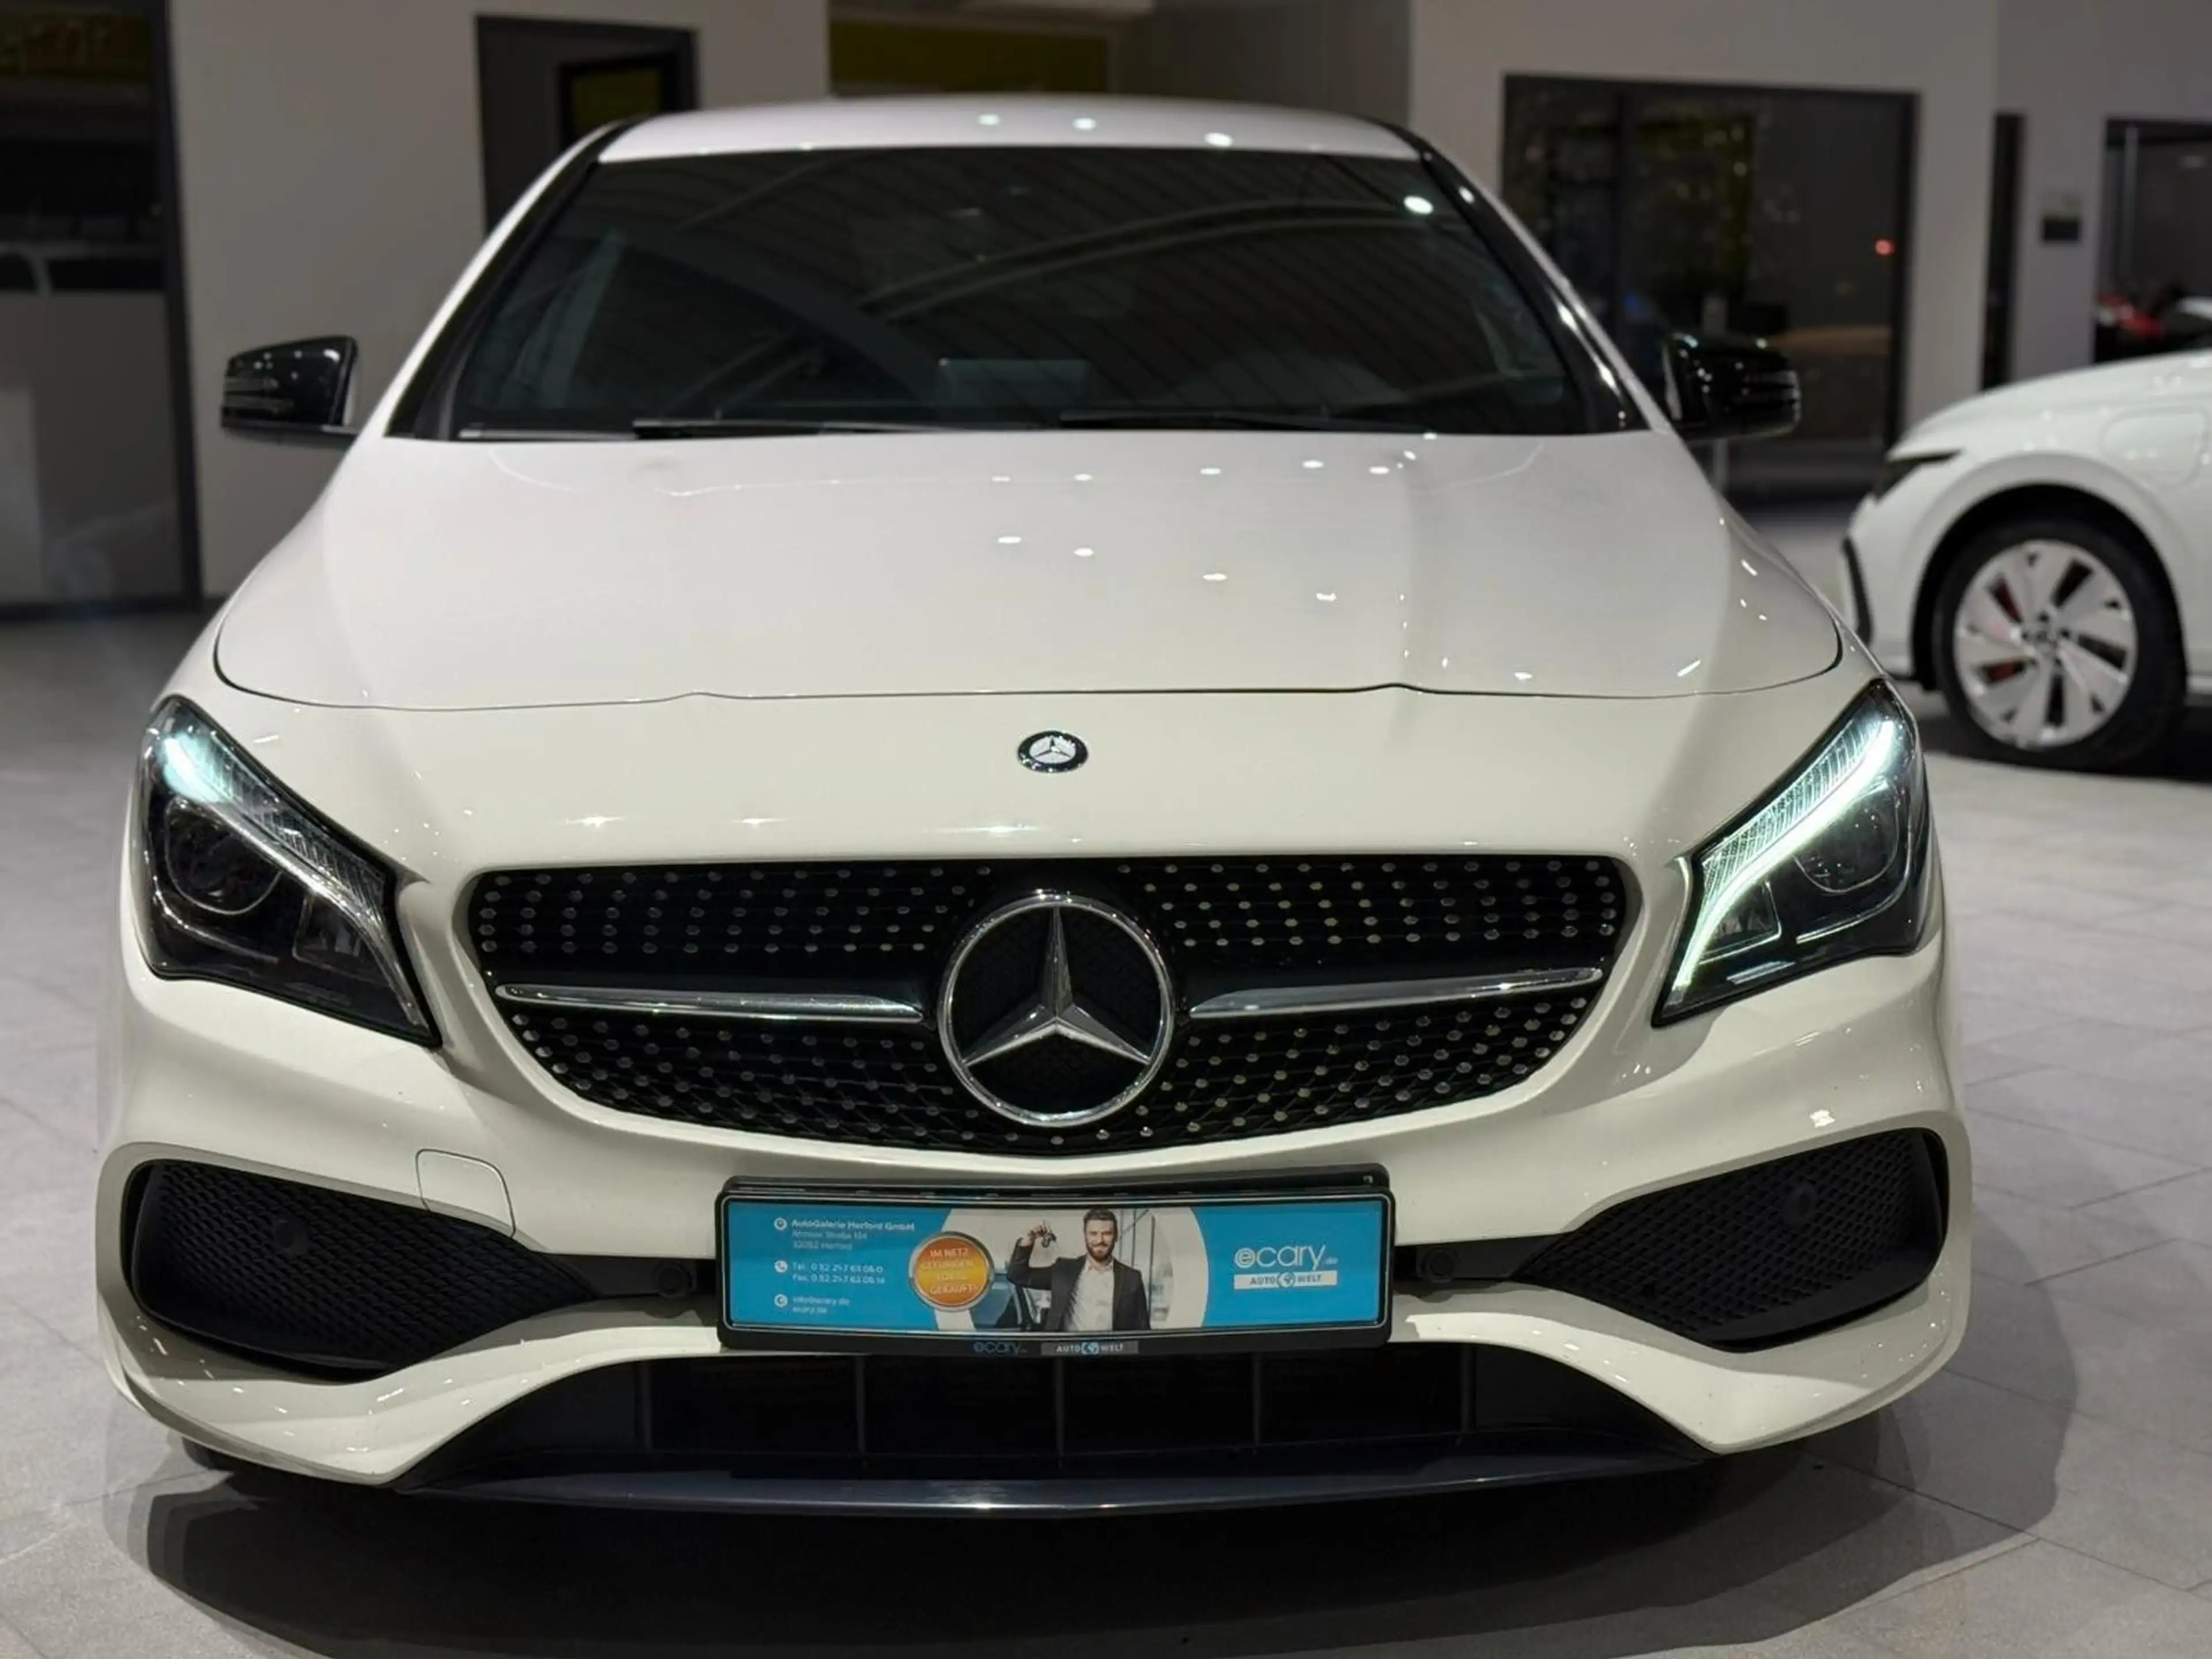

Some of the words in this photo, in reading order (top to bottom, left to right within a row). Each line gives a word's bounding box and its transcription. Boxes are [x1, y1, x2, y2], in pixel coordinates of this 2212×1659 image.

[1249, 1275, 1275, 1285] AUTO
[1297, 1274, 1321, 1284] WELT
[1056, 1344, 1081, 1352] AUTO
[1101, 1343, 1123, 1352] WELT
